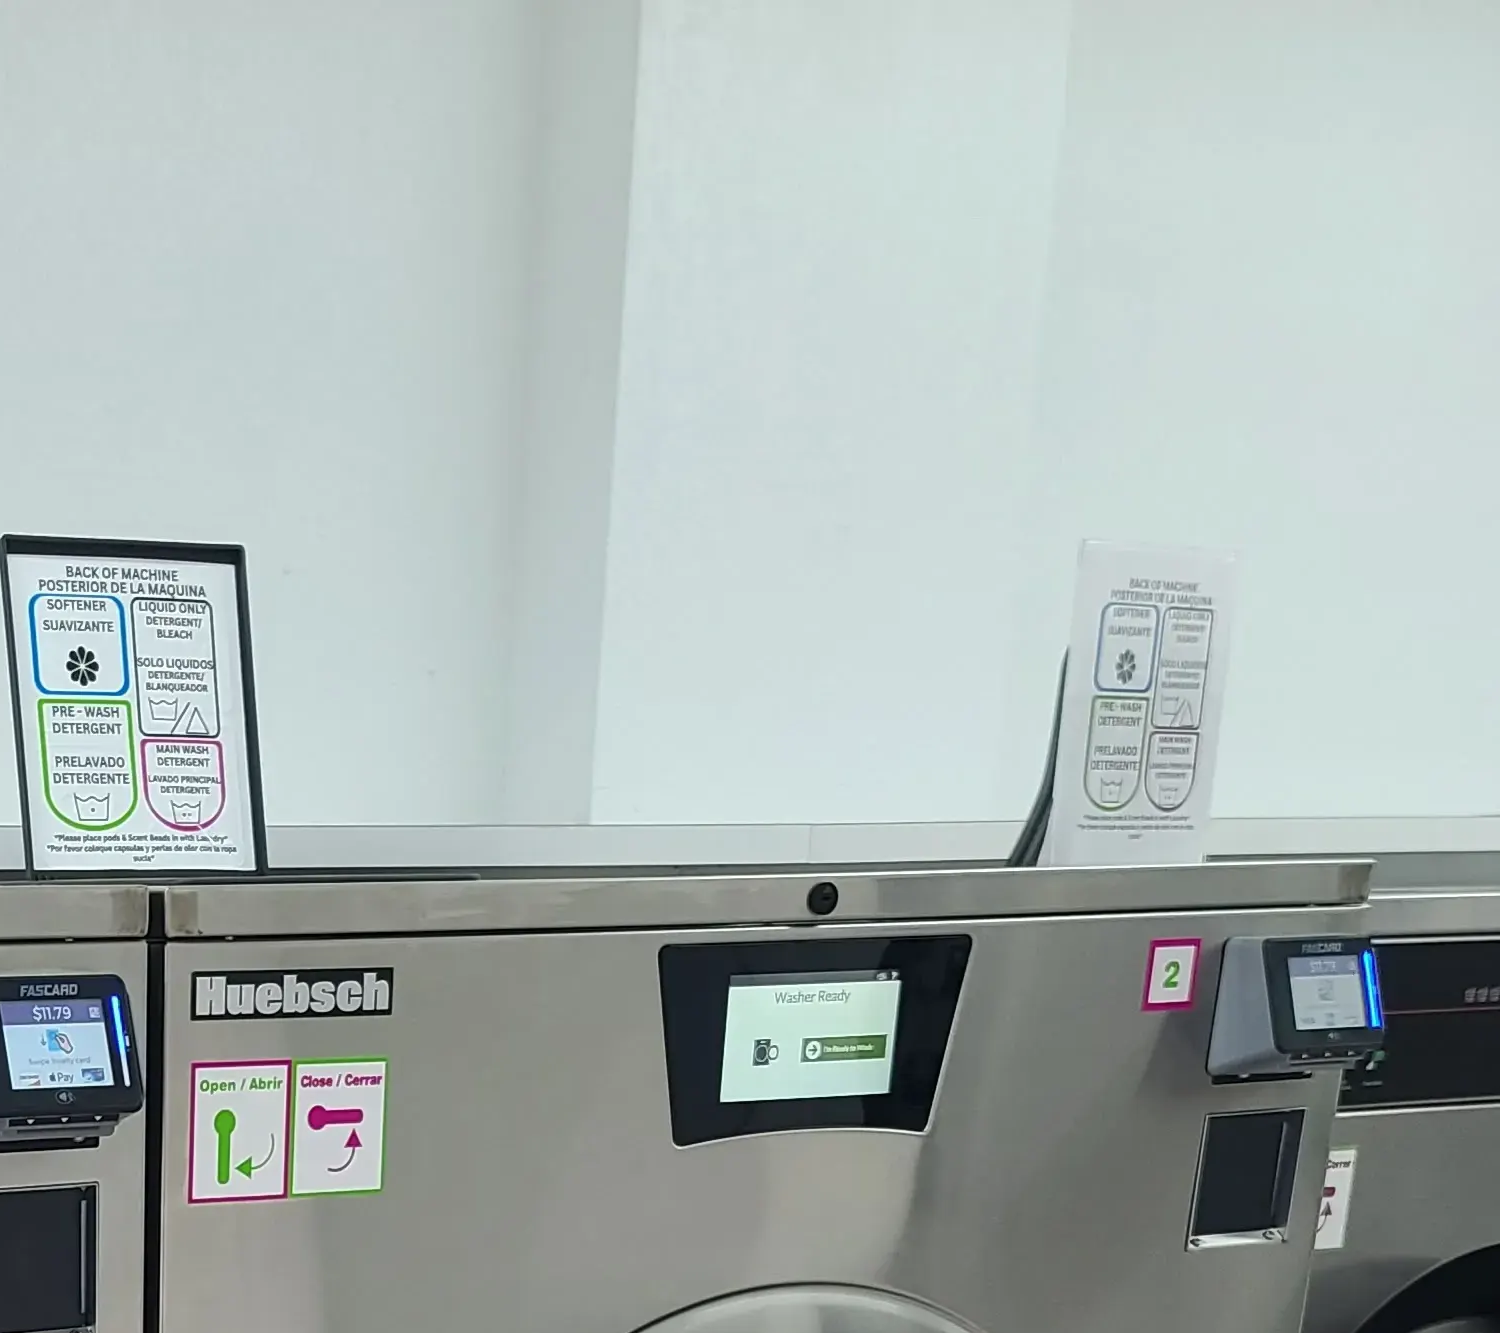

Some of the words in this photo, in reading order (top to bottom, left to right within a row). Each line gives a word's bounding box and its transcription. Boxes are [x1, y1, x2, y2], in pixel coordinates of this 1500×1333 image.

[66, 565, 99, 579] BACK
[102, 567, 119, 580] OF
[121, 568, 179, 582] MACHINE
[39, 579, 108, 594] POSTERIOR
[110, 581, 127, 594] DE
[130, 582, 145, 595] LA
[148, 583, 207, 599] MAQUINA
[46, 599, 107, 612] SOFTENER
[138, 602, 176, 615] LIQUID
[180, 603, 207, 615] ONLY
[43, 619, 114, 632] SUAVIZANTE
[146, 616, 202, 629] DETERGENT/
[156, 629, 193, 640] BLEACH
[137, 657, 164, 669] SOLO
[166, 658, 214, 672] LIQUIDOS
[146, 682, 208, 694] BLANQUEADOR
[52, 722, 122, 735] DETERGENT
[156, 744, 181, 755] MAIN
[182, 745, 209, 755] WASH
[55, 755, 125, 769] PRELAVADO
[157, 756, 210, 768] DETERGENT
[53, 772, 130, 785] DETERGENTE
[1161, 960, 1181, 989] 2
[19, 984, 79, 998] FASCARD
[195, 972, 390, 1016] Huebsch
[774, 991, 816, 1004] Washer
[818, 989, 851, 1003] Ready
[32, 1005, 73, 1022] $11.79
[57, 1072, 74, 1084] Pay
[300, 1075, 333, 1088] Close
[344, 1073, 383, 1087] Cerrar
[200, 1080, 236, 1094] Open
[249, 1077, 283, 1090] Abrir
